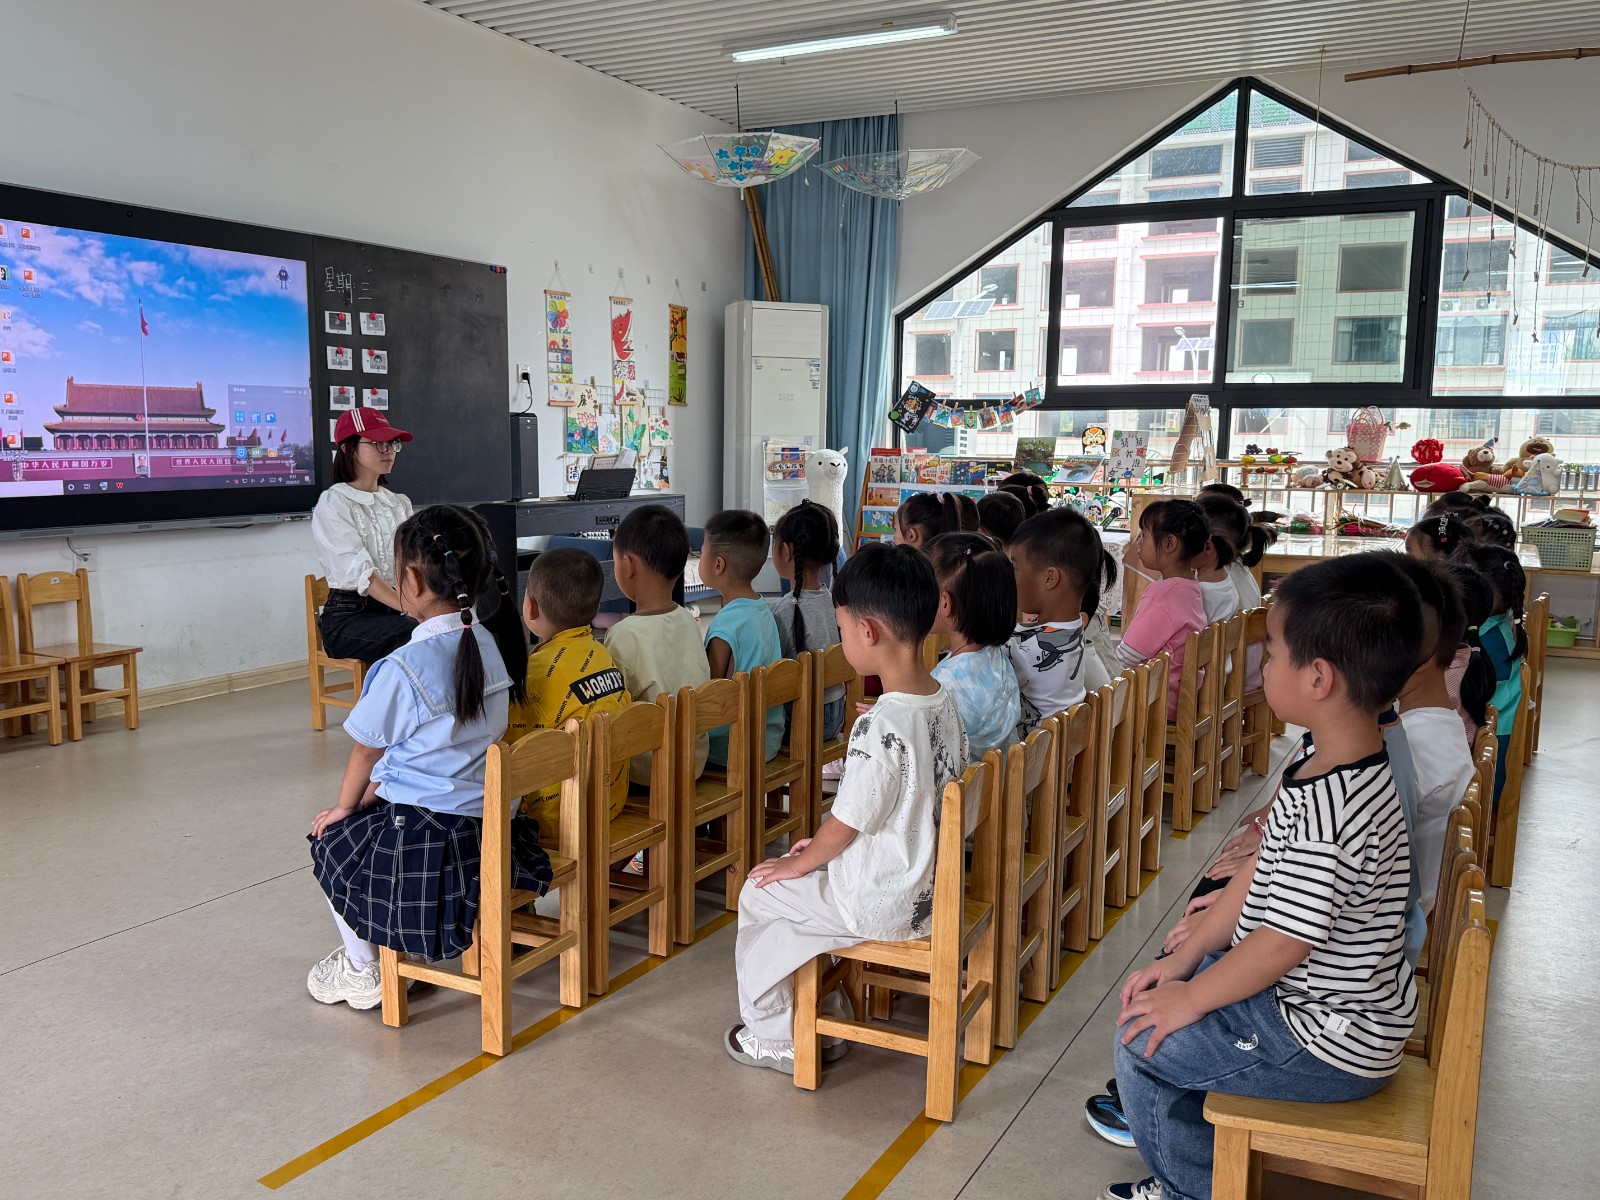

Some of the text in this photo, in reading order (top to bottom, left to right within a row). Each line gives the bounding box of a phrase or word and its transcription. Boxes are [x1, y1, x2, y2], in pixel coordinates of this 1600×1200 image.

[20, 460, 108, 469] 中华人民共和国万岁
